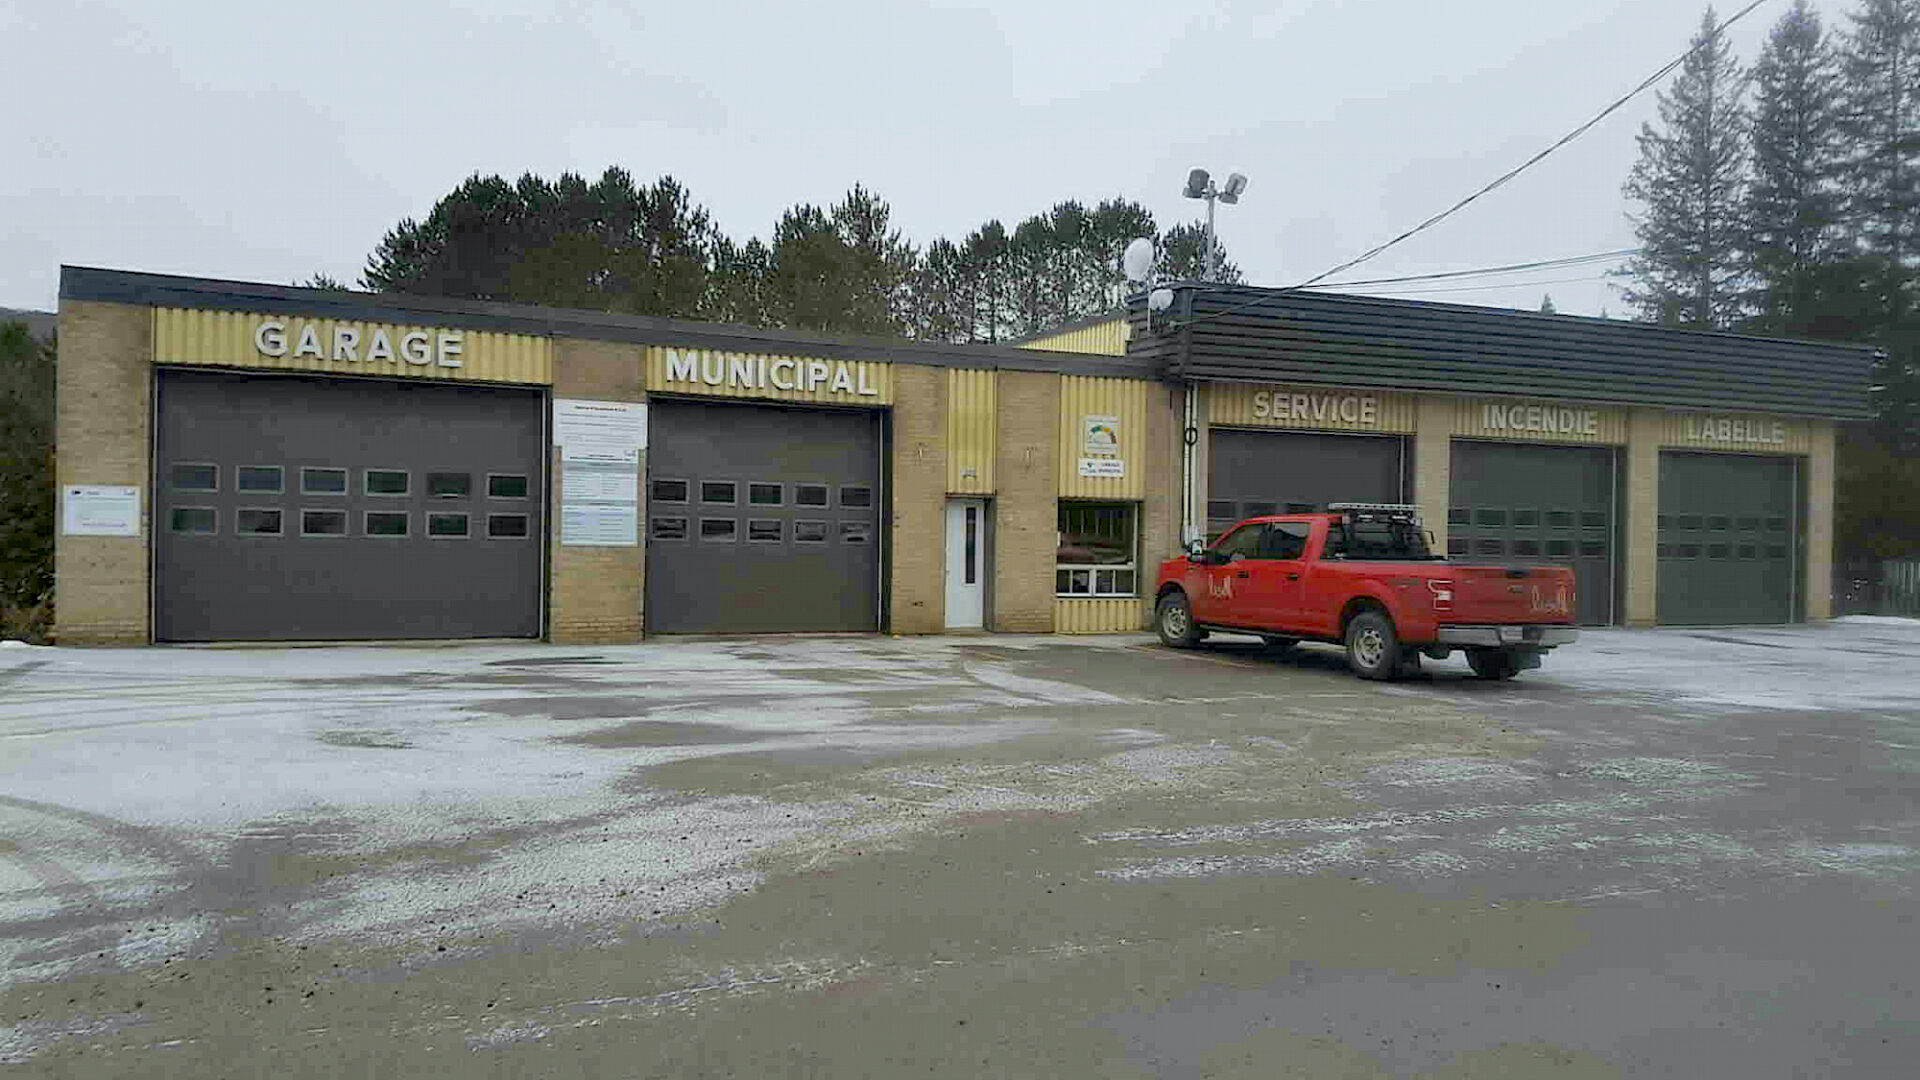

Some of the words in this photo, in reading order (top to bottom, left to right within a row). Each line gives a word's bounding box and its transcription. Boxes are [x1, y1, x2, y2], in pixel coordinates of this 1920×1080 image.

[255, 321, 464, 368] GARAGE
[666, 348, 878, 396] MUNICIPAL
[1253, 391, 1376, 424] SERVICE
[1483, 405, 1597, 435] INCENDIE
[1687, 416, 1785, 444] LABELLE
